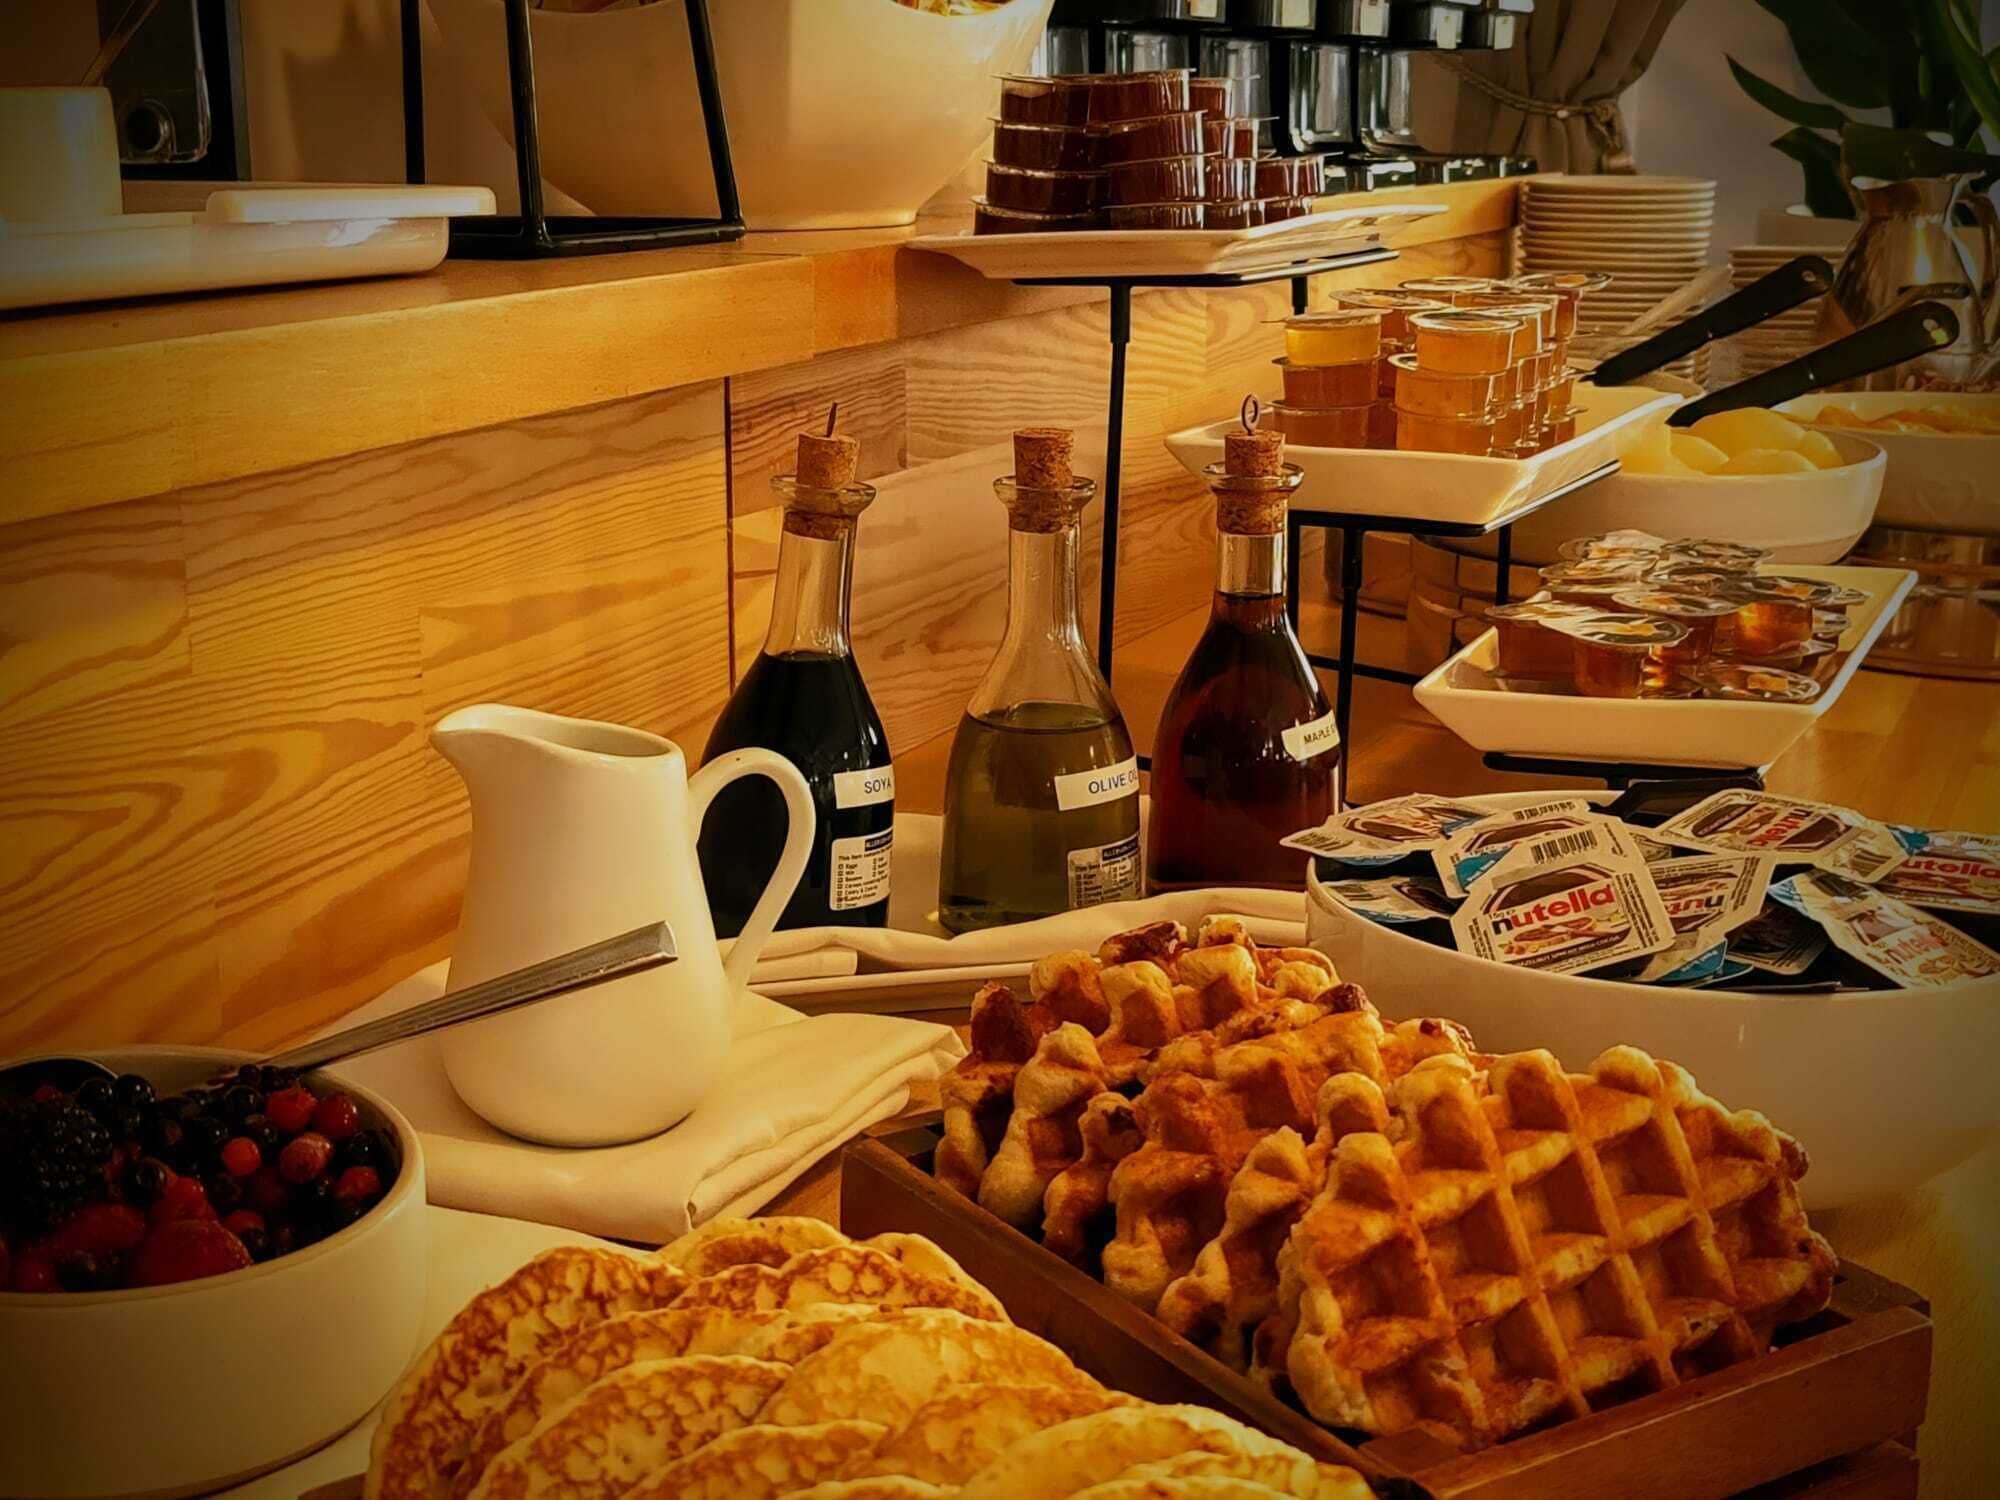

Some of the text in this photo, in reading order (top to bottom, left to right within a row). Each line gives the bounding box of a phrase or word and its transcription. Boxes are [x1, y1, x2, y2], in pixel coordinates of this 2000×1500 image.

[864, 777, 892, 794] SOYA
[1088, 773, 1126, 794] OLIVE
[1901, 859, 2000, 879] utella
[1491, 884, 1616, 935] nutella
[1664, 895, 1725, 915] nut
